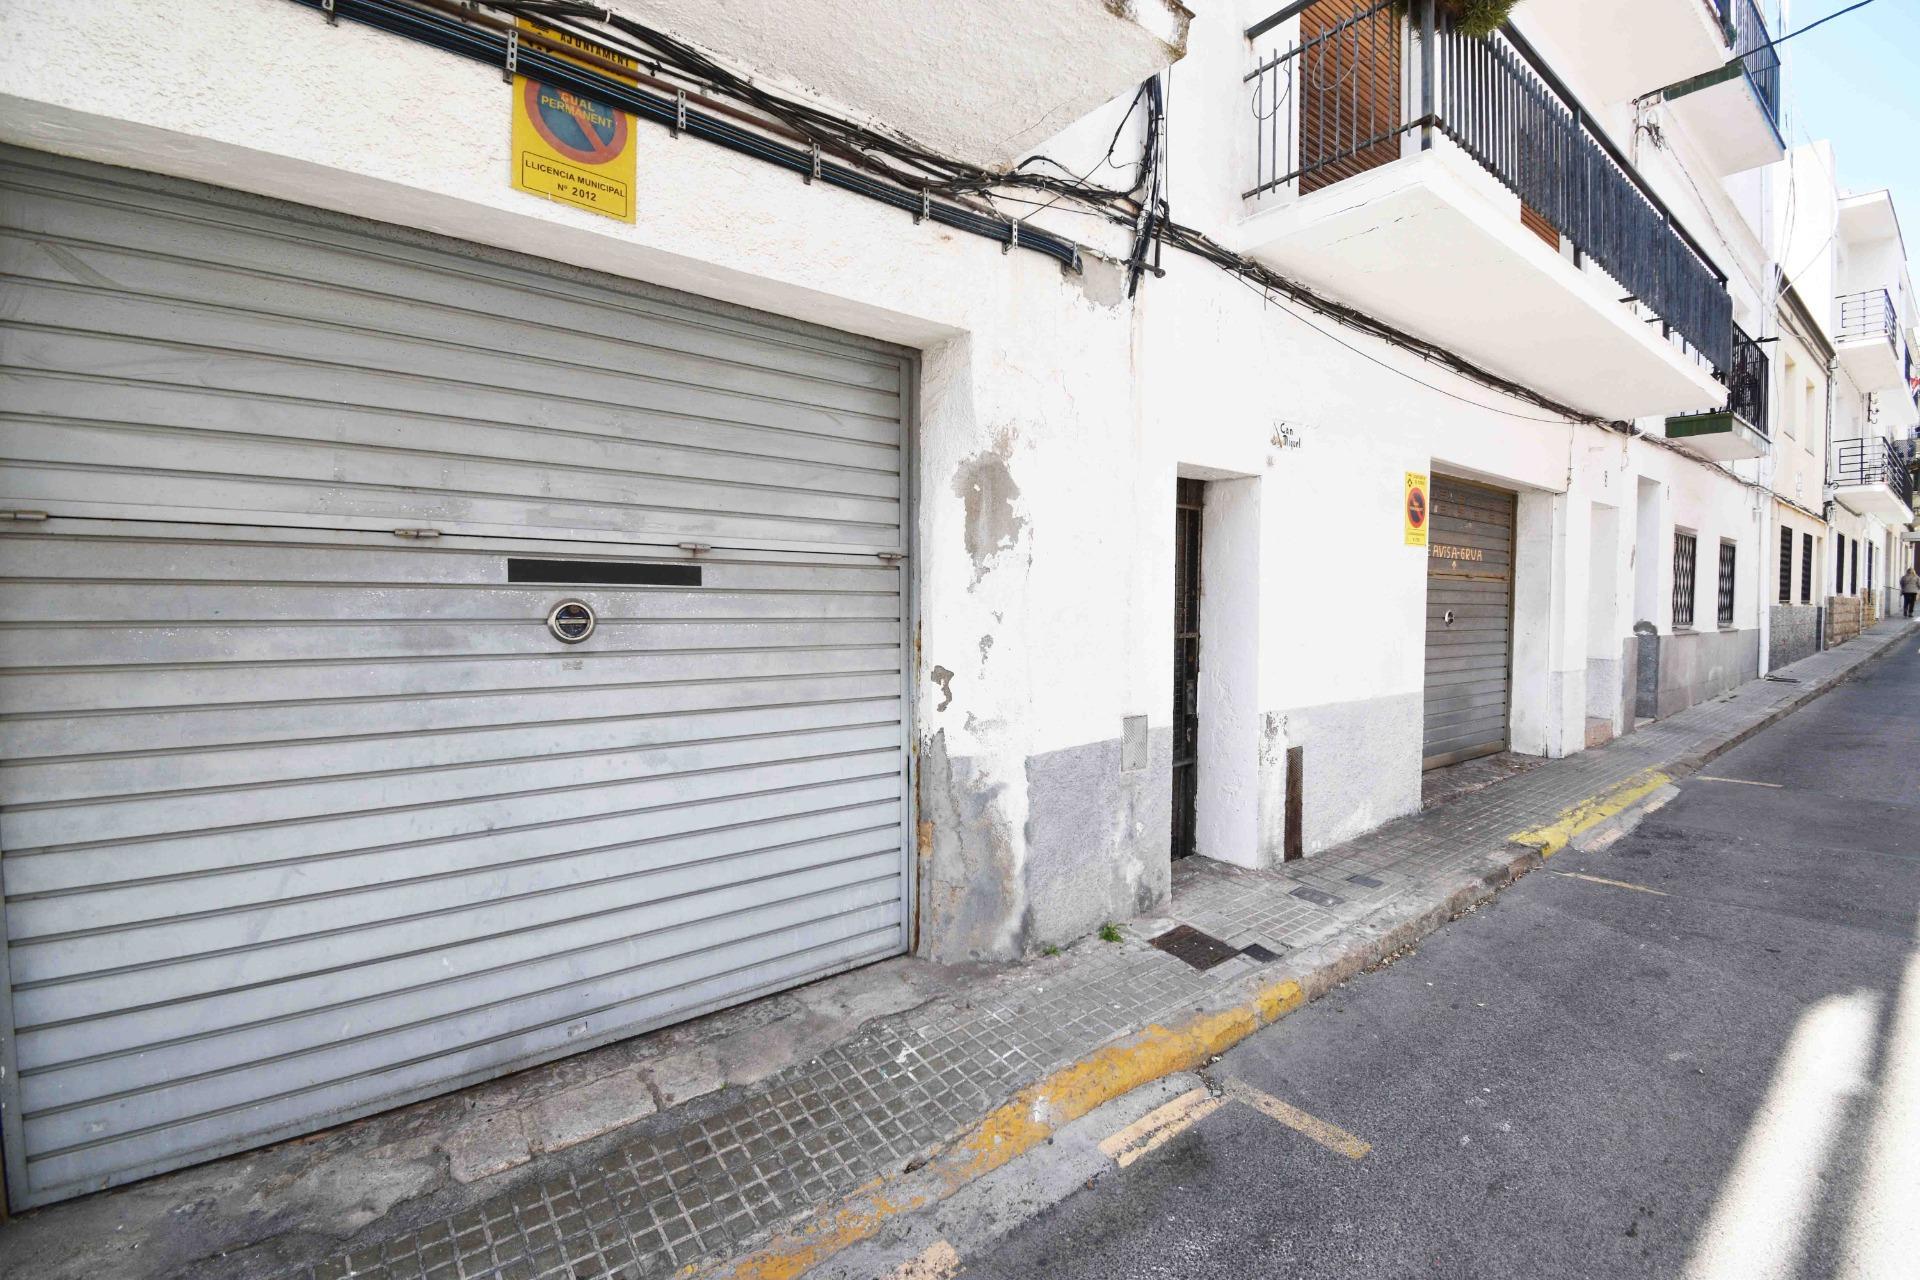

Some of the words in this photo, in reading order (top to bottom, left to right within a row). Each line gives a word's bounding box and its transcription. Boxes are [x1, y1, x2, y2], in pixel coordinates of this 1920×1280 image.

[560, 32, 629, 67] AJUNTAMENT
[541, 95, 613, 129] PERMANENT
[525, 160, 575, 182] LLICENCIA
[577, 175, 625, 197] MUNICIPAL
[572, 187, 597, 202] 2012
[1280, 422, 1294, 435] Can
